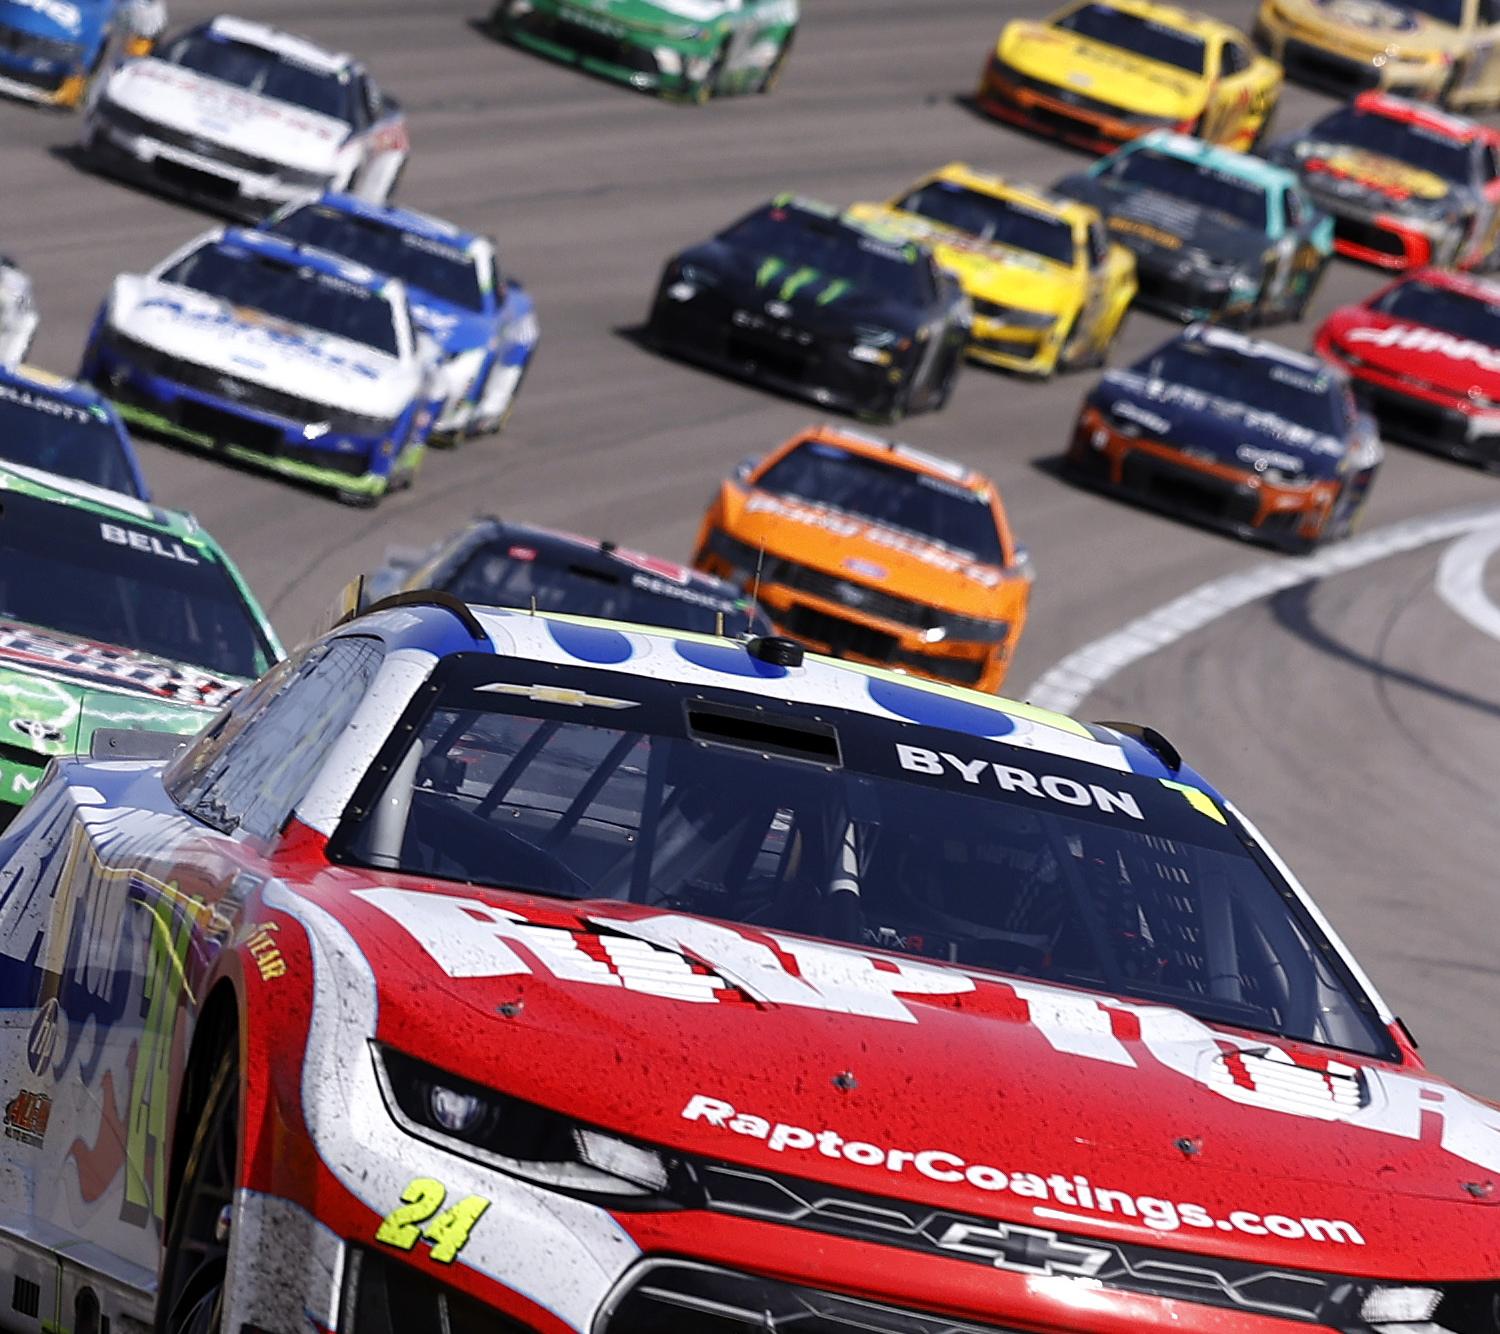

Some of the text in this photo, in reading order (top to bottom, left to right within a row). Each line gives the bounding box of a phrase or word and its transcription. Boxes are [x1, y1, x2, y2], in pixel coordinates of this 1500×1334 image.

[100, 522, 200, 566] BELL
[632, 574, 737, 614] REDDICK
[895, 742, 1146, 820] BYRON
[681, 1093, 1366, 1247] RaptorCoatings.com
[374, 1177, 492, 1265] 24
